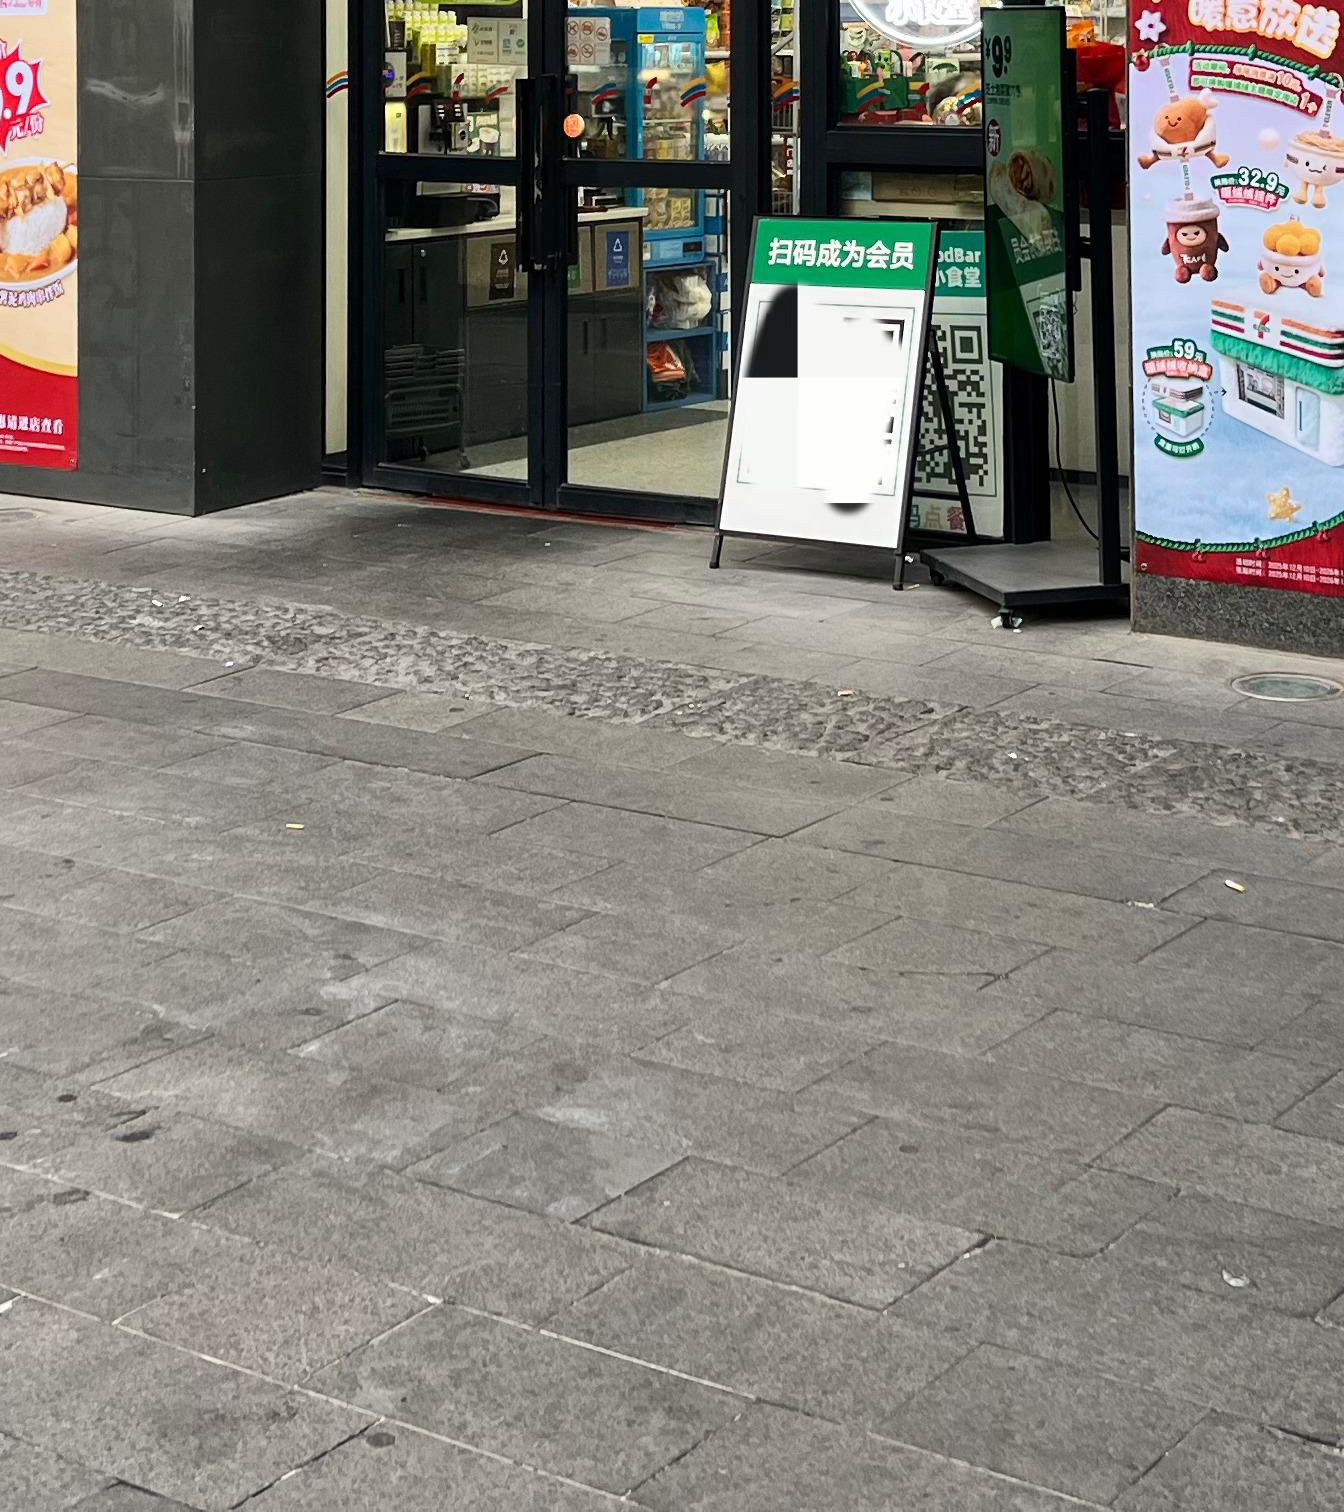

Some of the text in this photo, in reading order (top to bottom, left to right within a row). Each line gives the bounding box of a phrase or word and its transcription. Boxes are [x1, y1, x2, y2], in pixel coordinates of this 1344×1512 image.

[767, 236, 915, 271] 扫码成为会员
